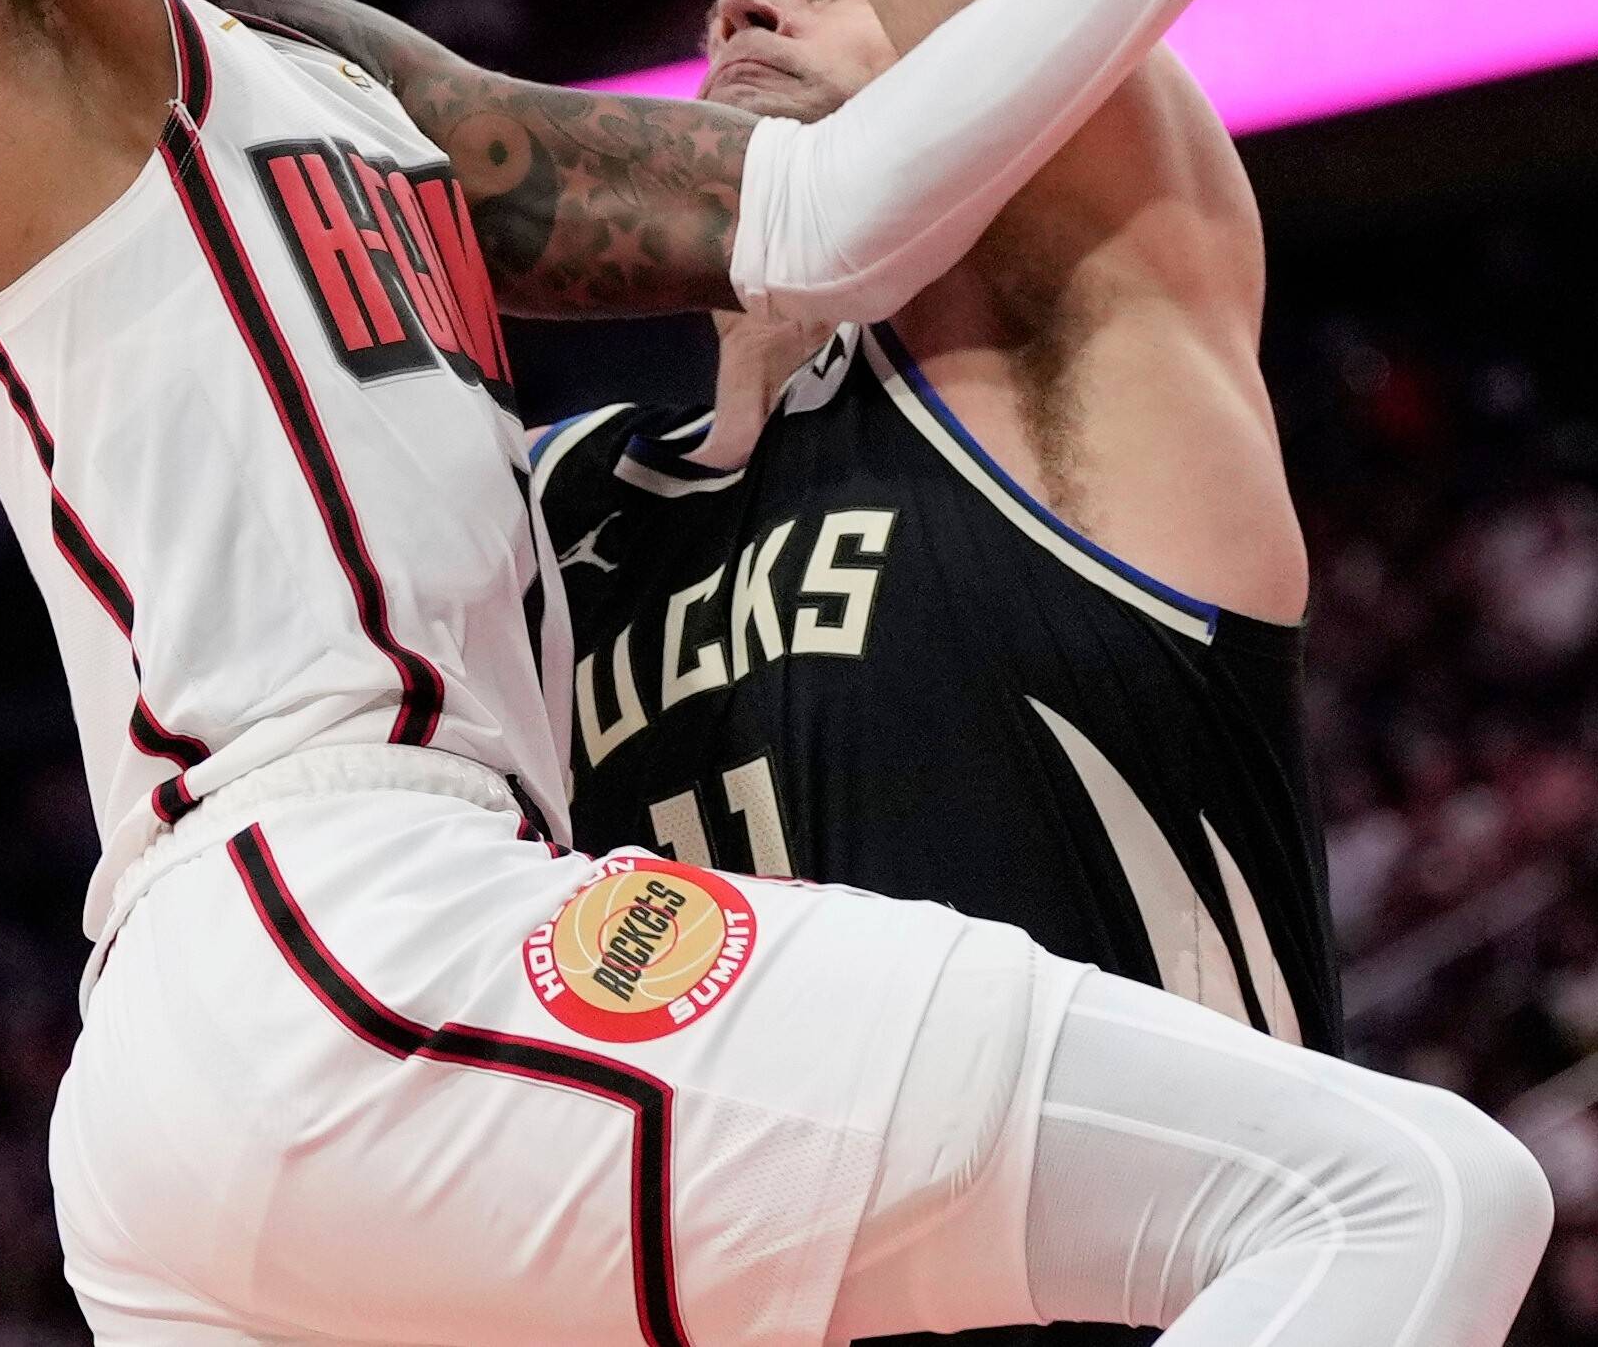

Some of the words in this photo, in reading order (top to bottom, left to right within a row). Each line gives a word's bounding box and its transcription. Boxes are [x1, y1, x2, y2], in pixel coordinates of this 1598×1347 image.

[575, 509, 898, 770] UCKS
[528, 858, 635, 1003] HOUN
[667, 908, 750, 1025] SUMMIT
